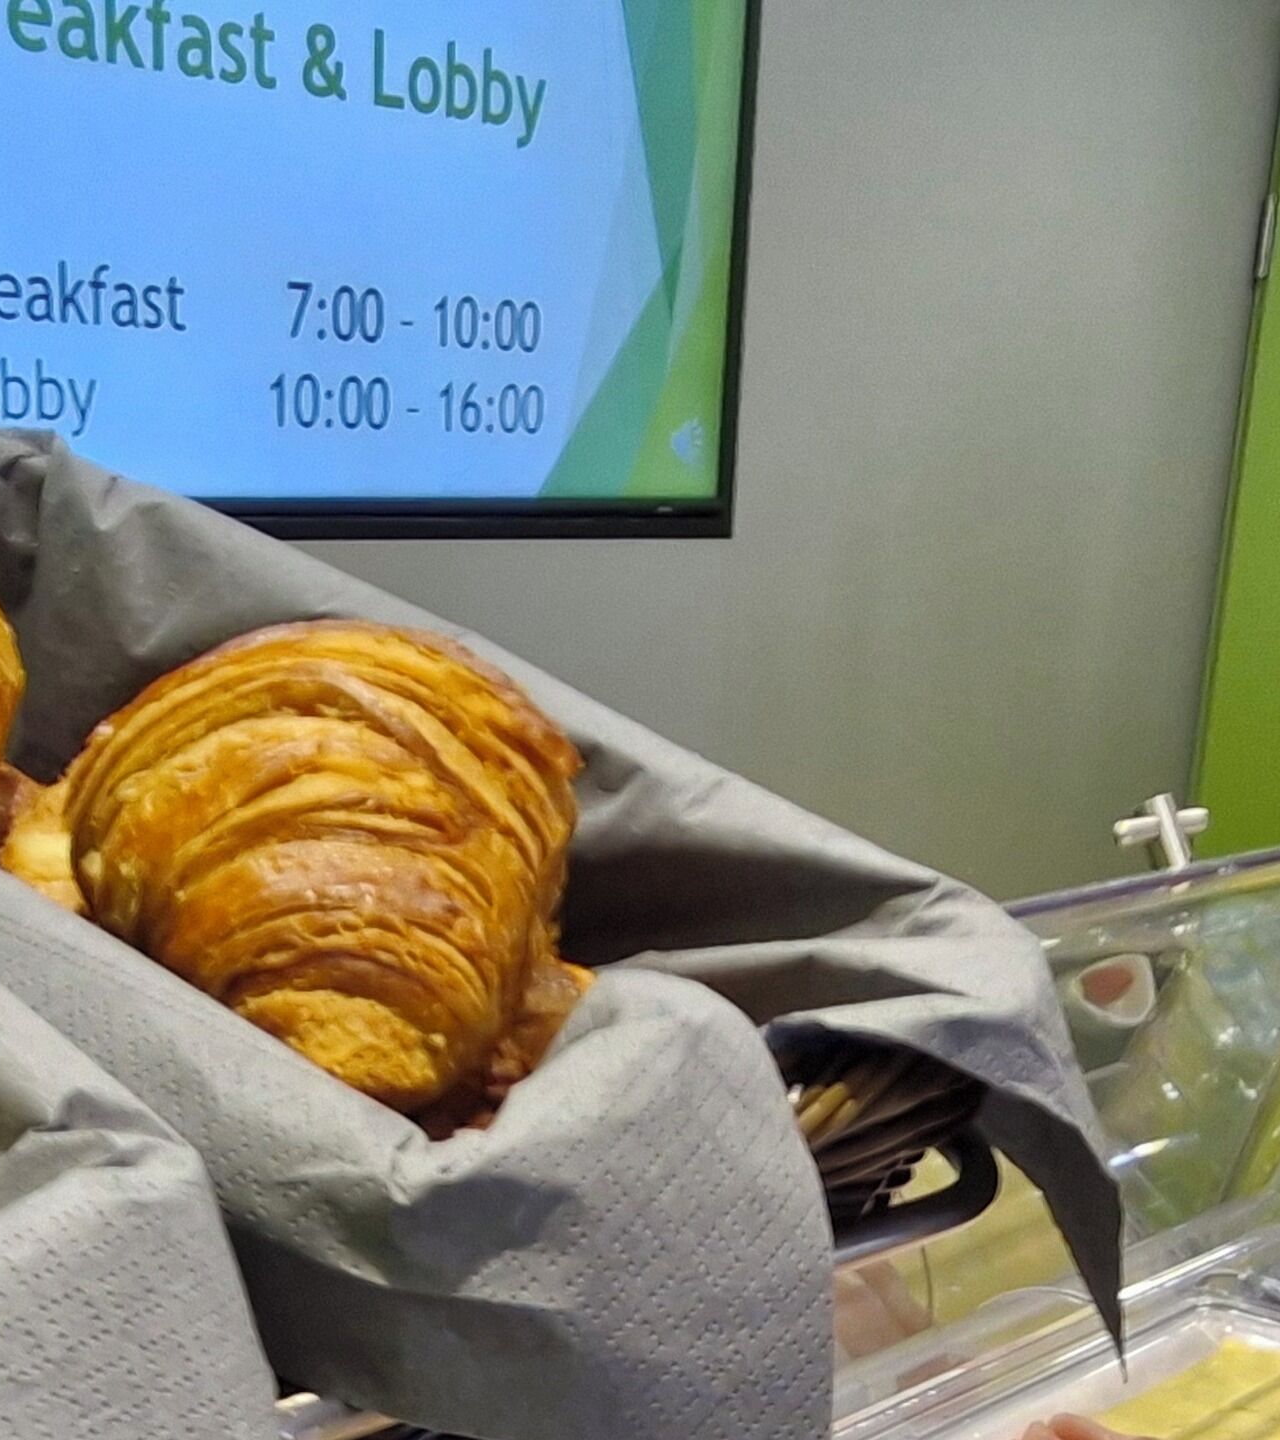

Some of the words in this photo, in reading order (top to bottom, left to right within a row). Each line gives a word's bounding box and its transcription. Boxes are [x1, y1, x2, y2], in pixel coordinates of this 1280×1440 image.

[303, 23, 347, 101] &
[373, 28, 547, 149] Lobby
[287, 281, 385, 344] 7:00
[433, 295, 542, 353] 10:00
[269, 373, 391, 431] 10:00
[439, 382, 544, 434] 16:00
